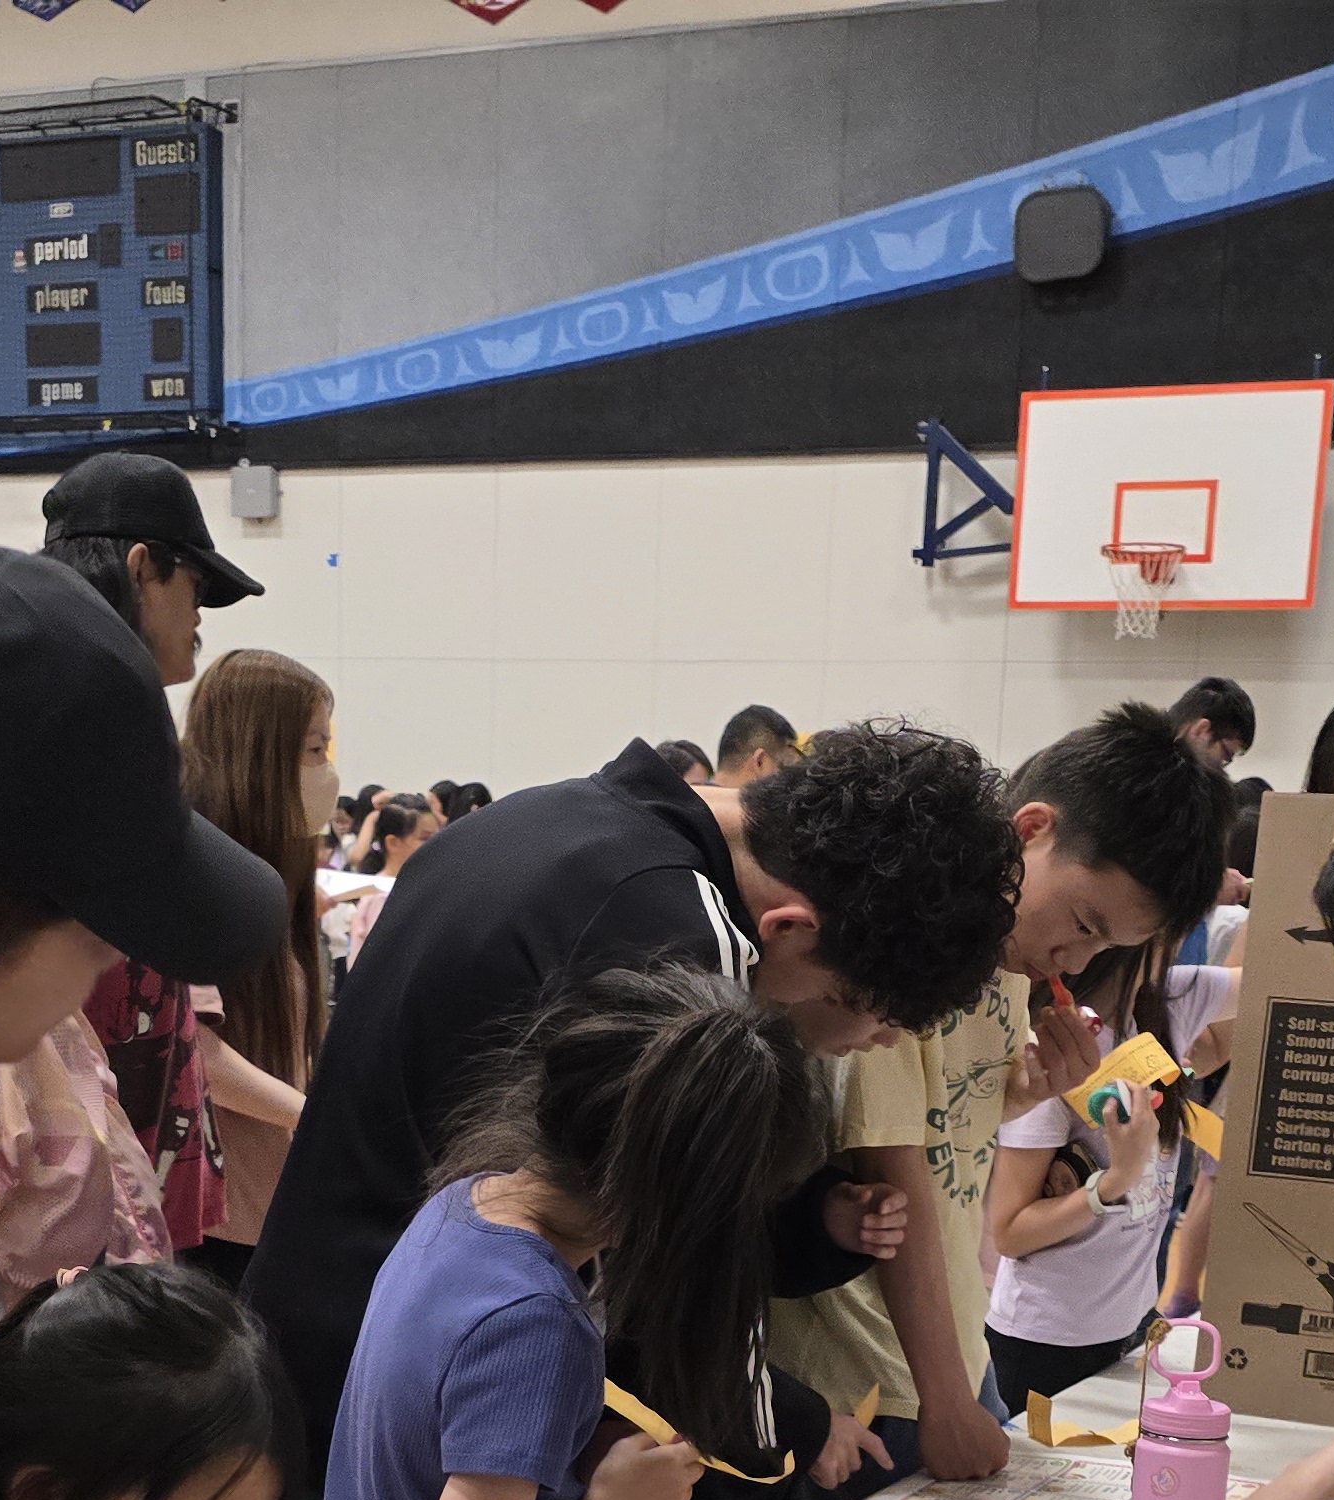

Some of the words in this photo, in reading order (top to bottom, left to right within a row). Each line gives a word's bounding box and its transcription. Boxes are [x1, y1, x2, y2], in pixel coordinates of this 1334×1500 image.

[33, 233, 88, 264] period
[34, 284, 88, 314] player
[145, 281, 186, 306] fouls
[41, 380, 83, 407] game
[151, 377, 185, 398] won
[1284, 1050, 1328, 1067] Heavy
[1279, 1088, 1324, 1105] Aucun
[1275, 1121, 1330, 1138] Surface
[1273, 1137, 1321, 1154] Carton
